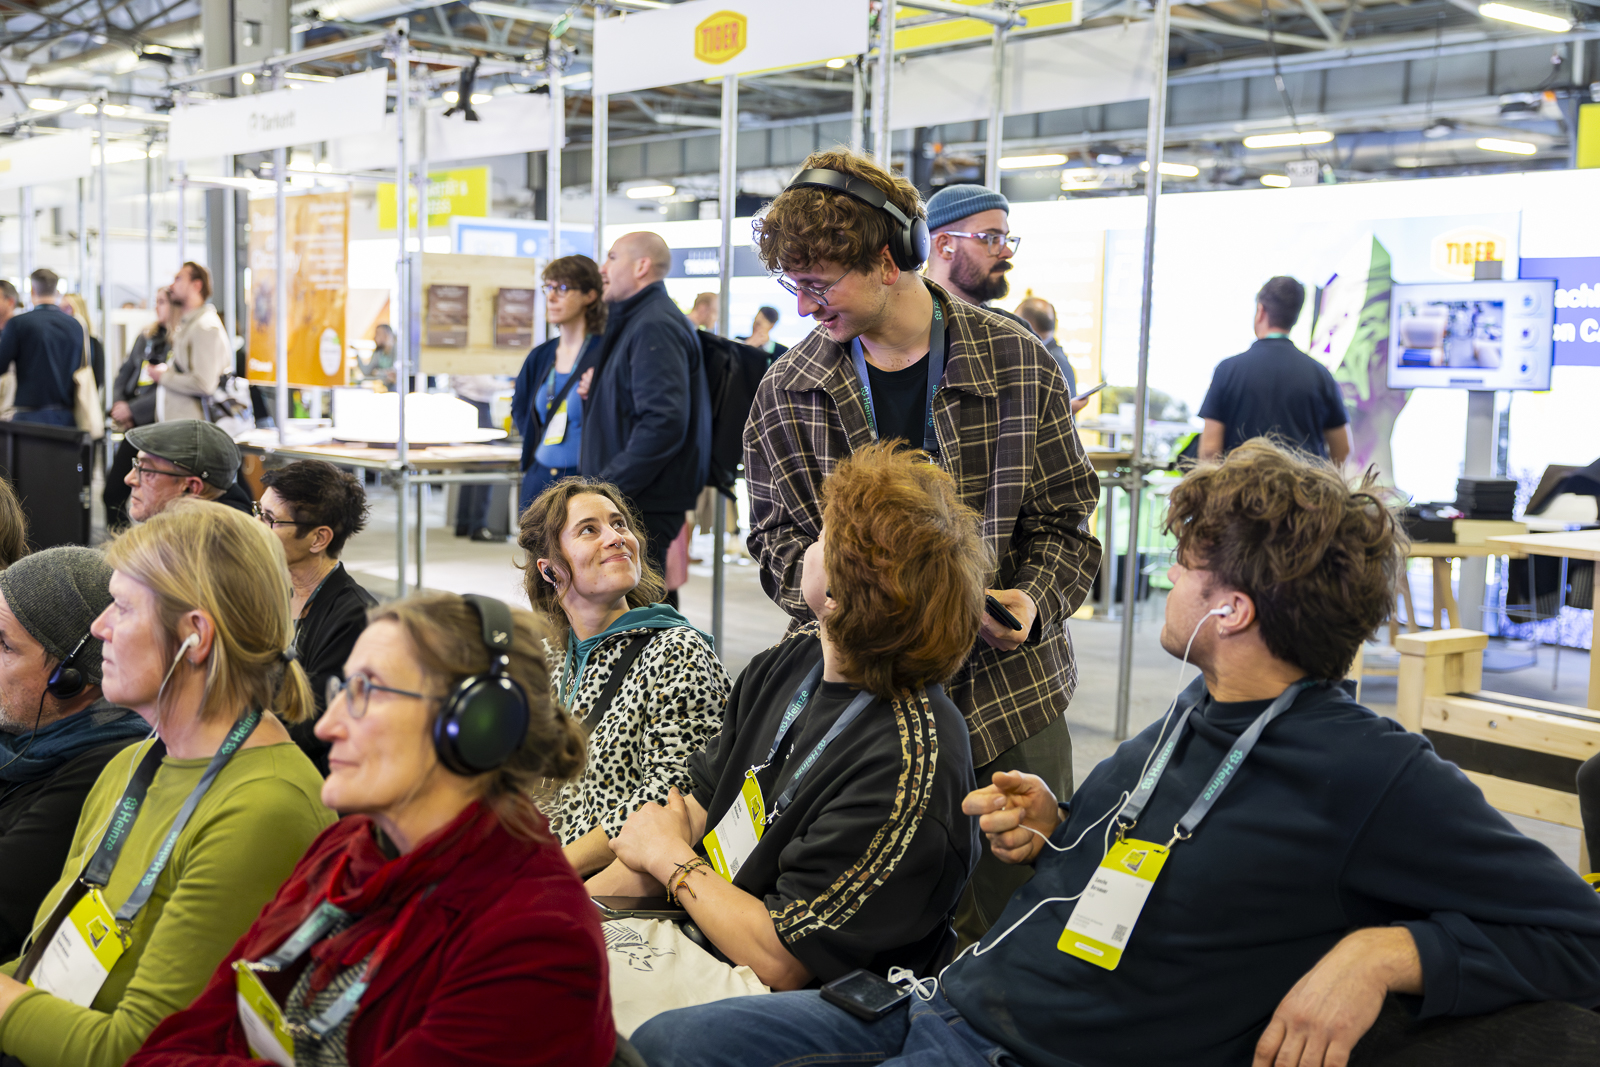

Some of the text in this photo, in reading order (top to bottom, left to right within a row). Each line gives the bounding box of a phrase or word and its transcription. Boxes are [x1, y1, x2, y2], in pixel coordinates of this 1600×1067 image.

[702, 22, 739, 54] TIGER
[1446, 241, 1496, 264] TIGER
[864, 397, 874, 428] Heinze
[785, 690, 809, 720] Heinze
[793, 750, 819, 780] Heinze
[1149, 741, 1174, 777] Heinze
[1203, 762, 1234, 801] Heinze
[104, 811, 131, 851] Heinze
[151, 831, 179, 875] Heinze
